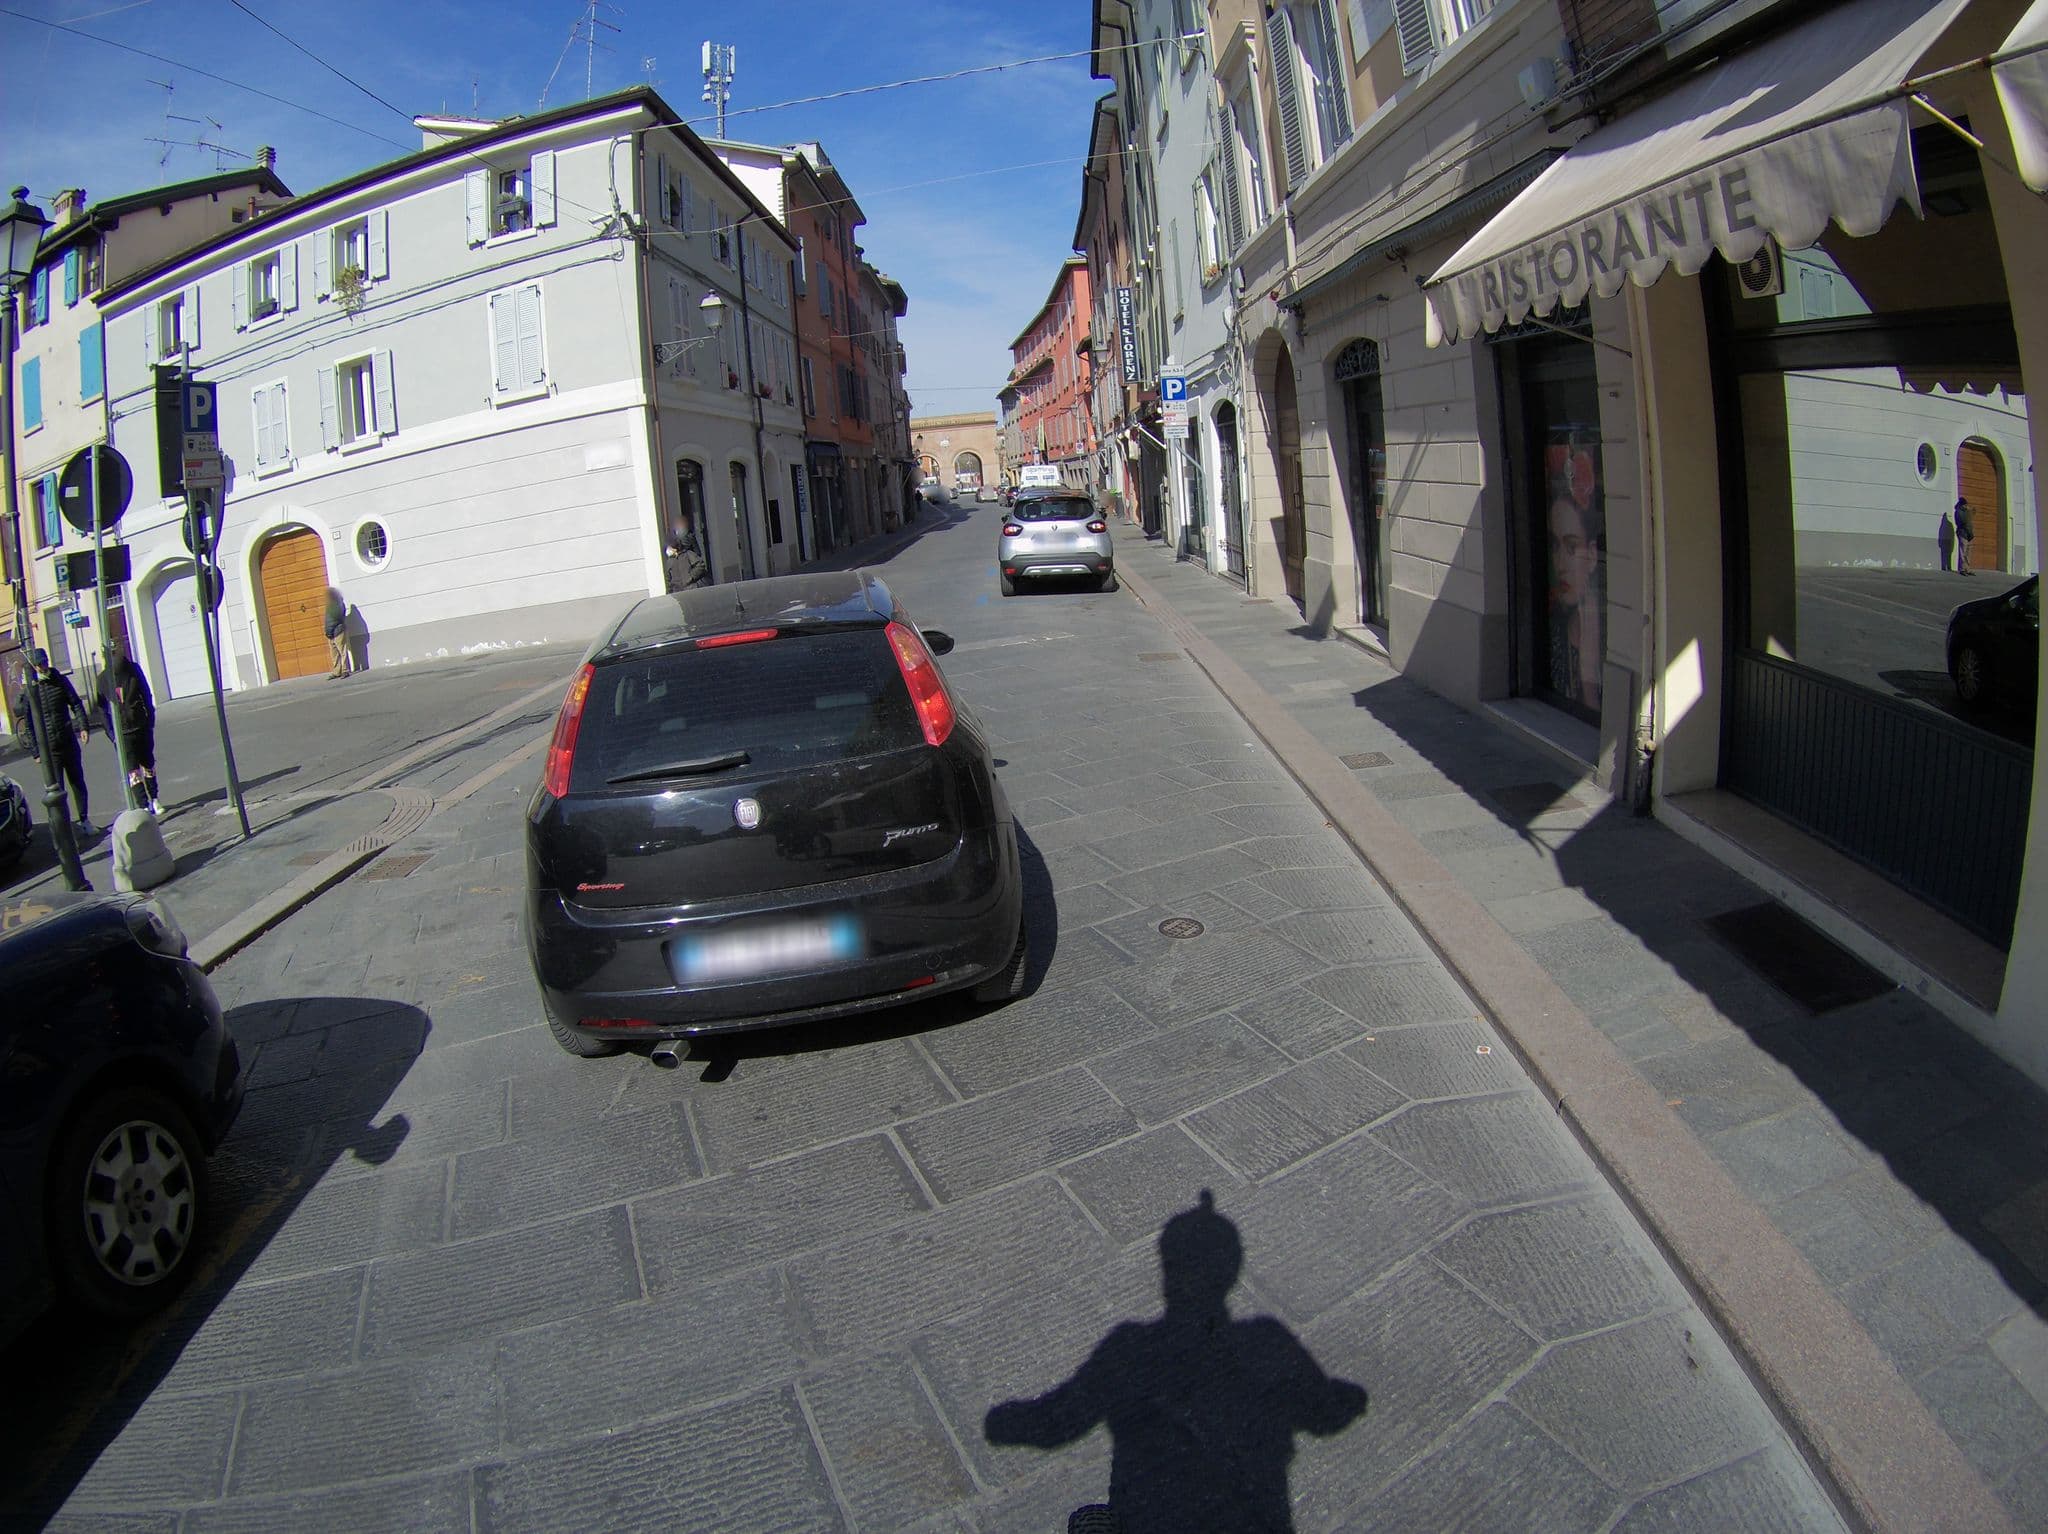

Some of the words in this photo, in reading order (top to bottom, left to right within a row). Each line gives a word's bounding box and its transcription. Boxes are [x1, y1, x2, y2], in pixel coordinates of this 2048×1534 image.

[1481, 168, 1757, 313] RISTORANTE
[1119, 289, 1131, 326] HOTEL
[189, 386, 212, 428] P
[1166, 379, 1183, 400] P
[57, 565, 68, 581] P
